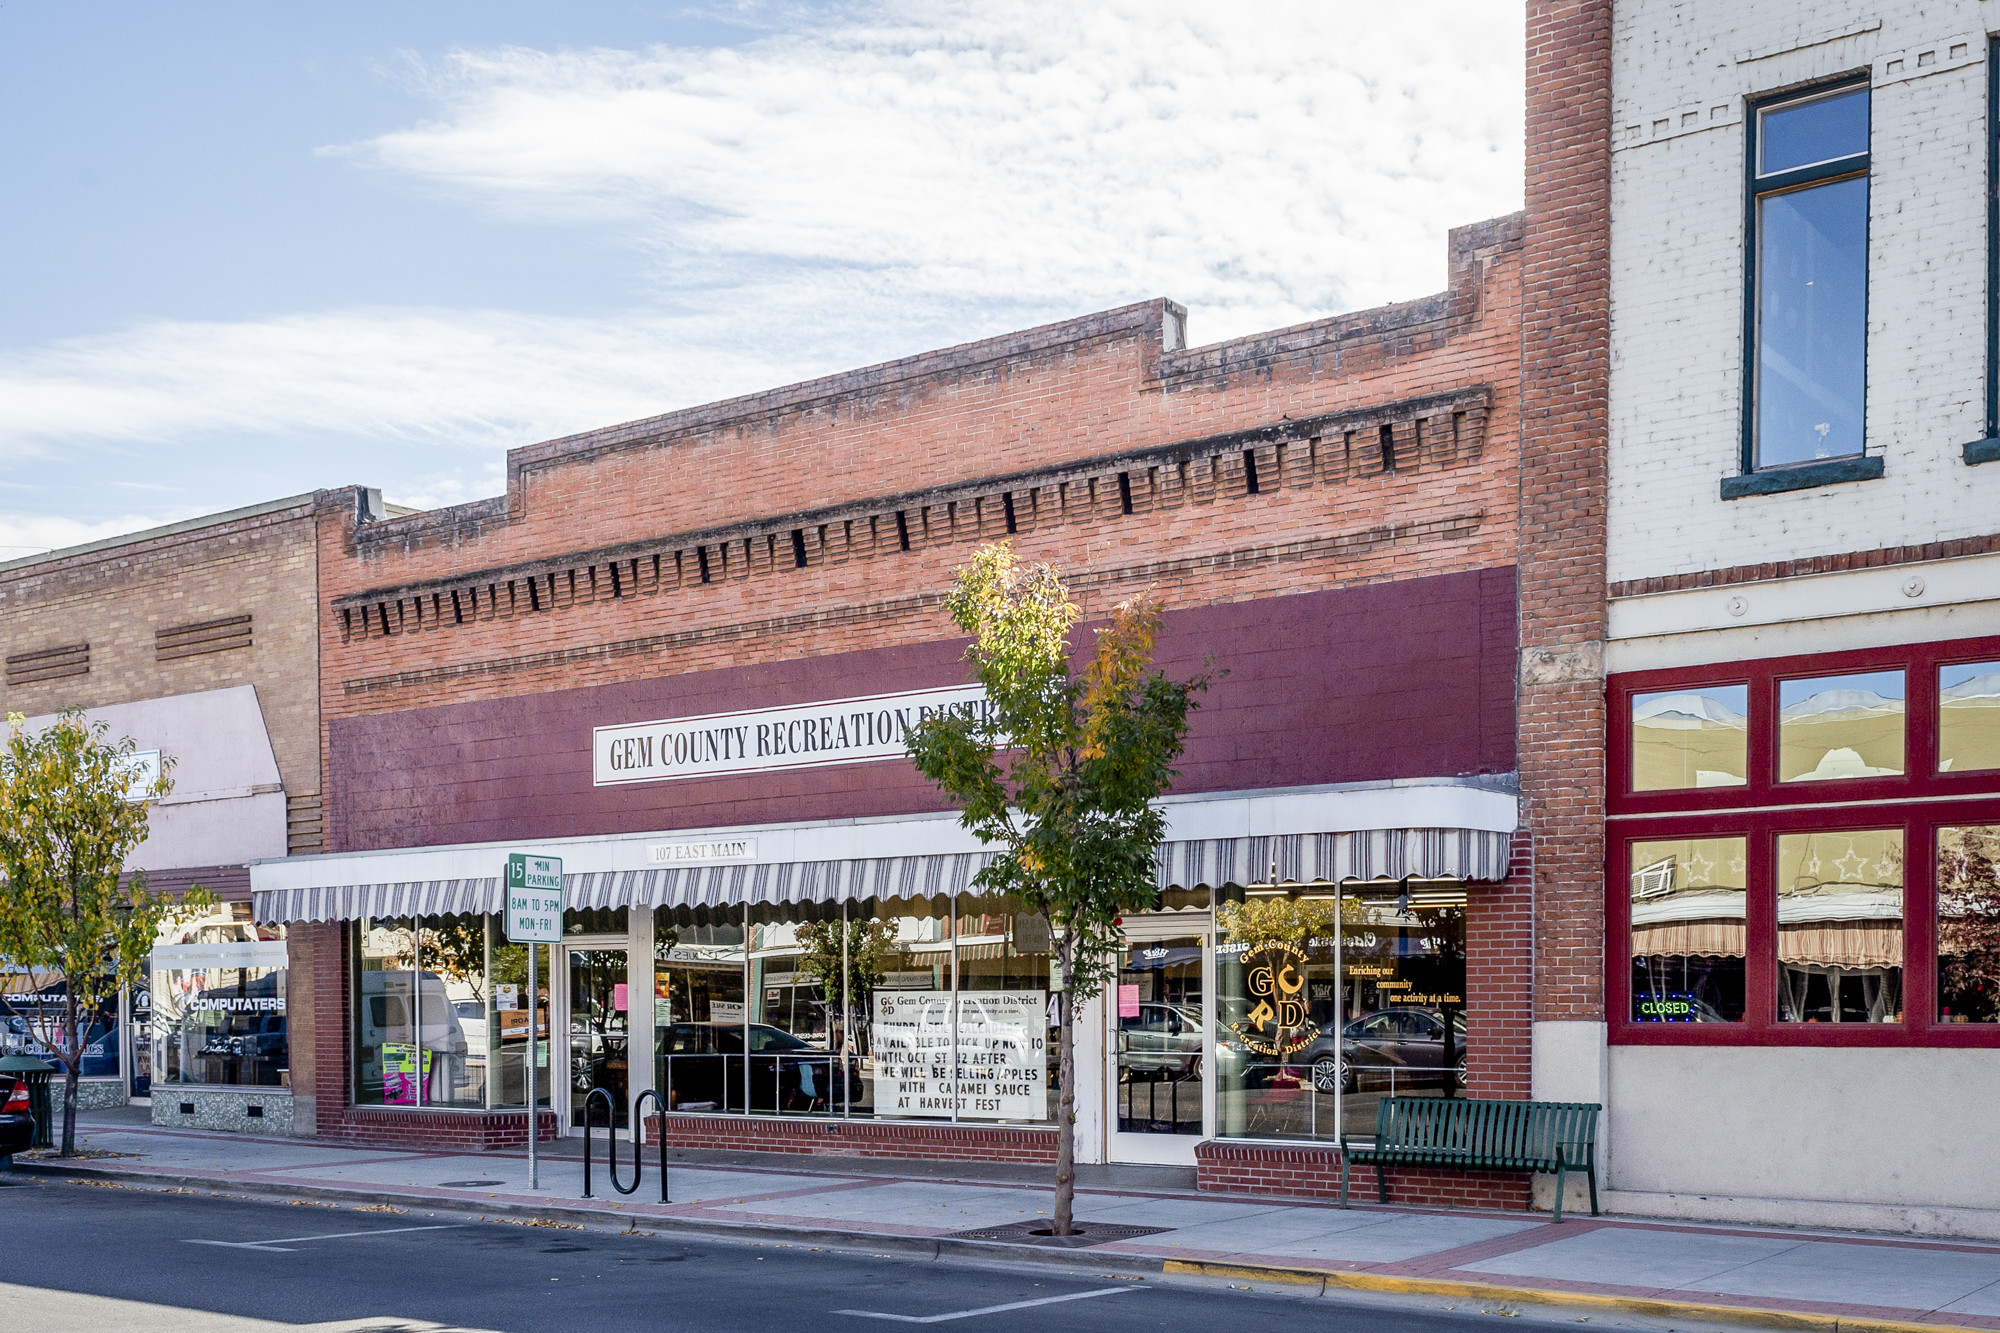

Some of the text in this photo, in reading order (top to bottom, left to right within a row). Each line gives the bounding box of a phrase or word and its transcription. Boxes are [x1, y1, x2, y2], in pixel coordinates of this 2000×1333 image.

[610, 699, 996, 770] GEM COUNTY RECREATION DISTR
[655, 842, 746, 860] 107 EAST MAIN
[511, 860, 550, 879] 15 MIN
[527, 874, 560, 887] PARKING
[511, 897, 560, 912] 8AM TO 5PM
[519, 917, 552, 931] MON-FRI
[1240, 943, 1265, 964] Gem
[1268, 938, 1310, 963] County
[1349, 965, 1394, 977] Enriching our
[1376, 978, 1413, 991] community
[190, 997, 286, 1011] COMPUTATERS
[897, 996, 917, 1005] Gem
[1003, 995, 1037, 1005] District
[1390, 992, 1461, 1005] one activity at a time.
[1641, 1002, 1690, 1014] CLOSED
[985, 1037, 999, 1049] UP
[1230, 1021, 1322, 1056] Recreation District
[907, 1052, 927, 1063] OCT
[973, 1053, 1006, 1064] AFTER
[881, 1066, 896, 1078] WE
[901, 1066, 927, 1078] WILL
[932, 1067, 946, 1078] BE
[899, 1081, 926, 1093] WITH
[994, 1084, 1030, 1096] SAUCE
[898, 1097, 1001, 1111] AT HARVEST FEST
